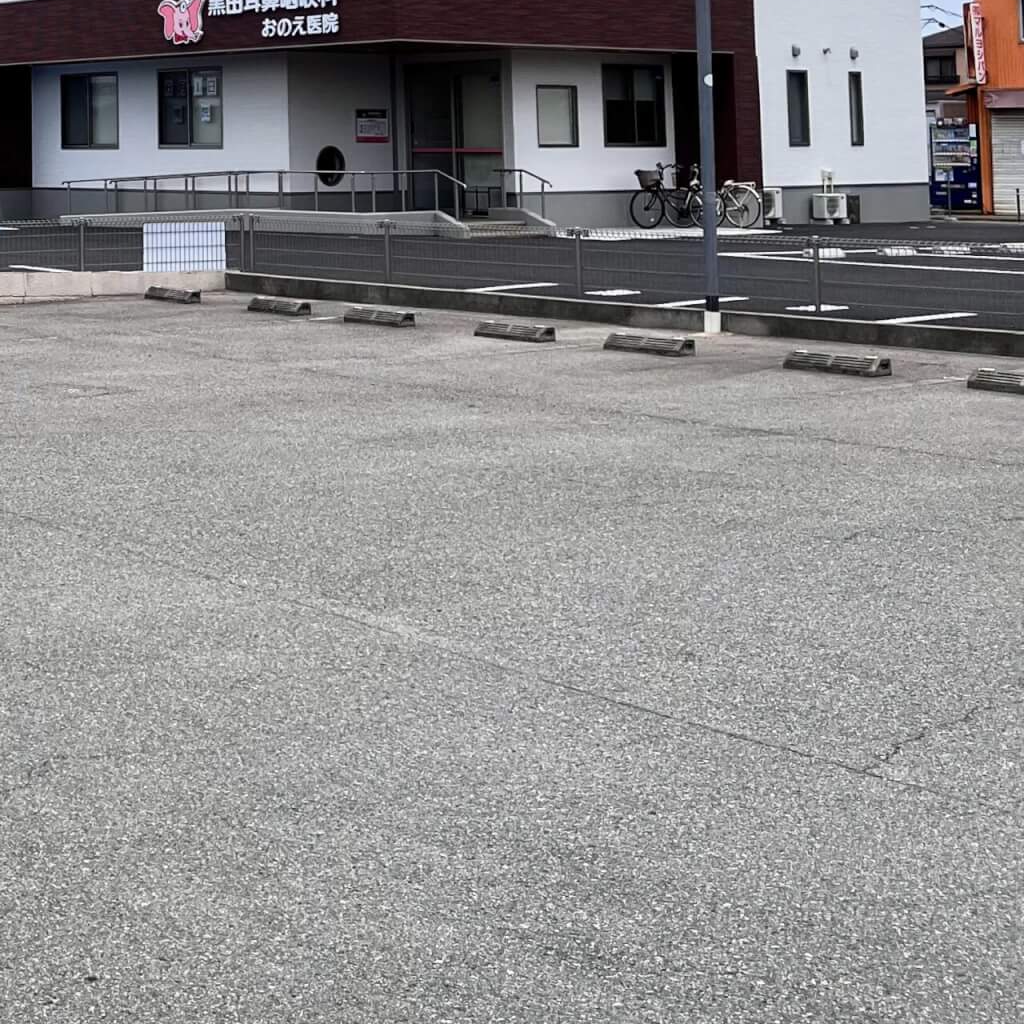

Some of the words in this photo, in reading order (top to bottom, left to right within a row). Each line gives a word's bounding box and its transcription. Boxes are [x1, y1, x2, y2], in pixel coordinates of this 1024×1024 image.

[261, 13, 339, 38] おのえ医院
